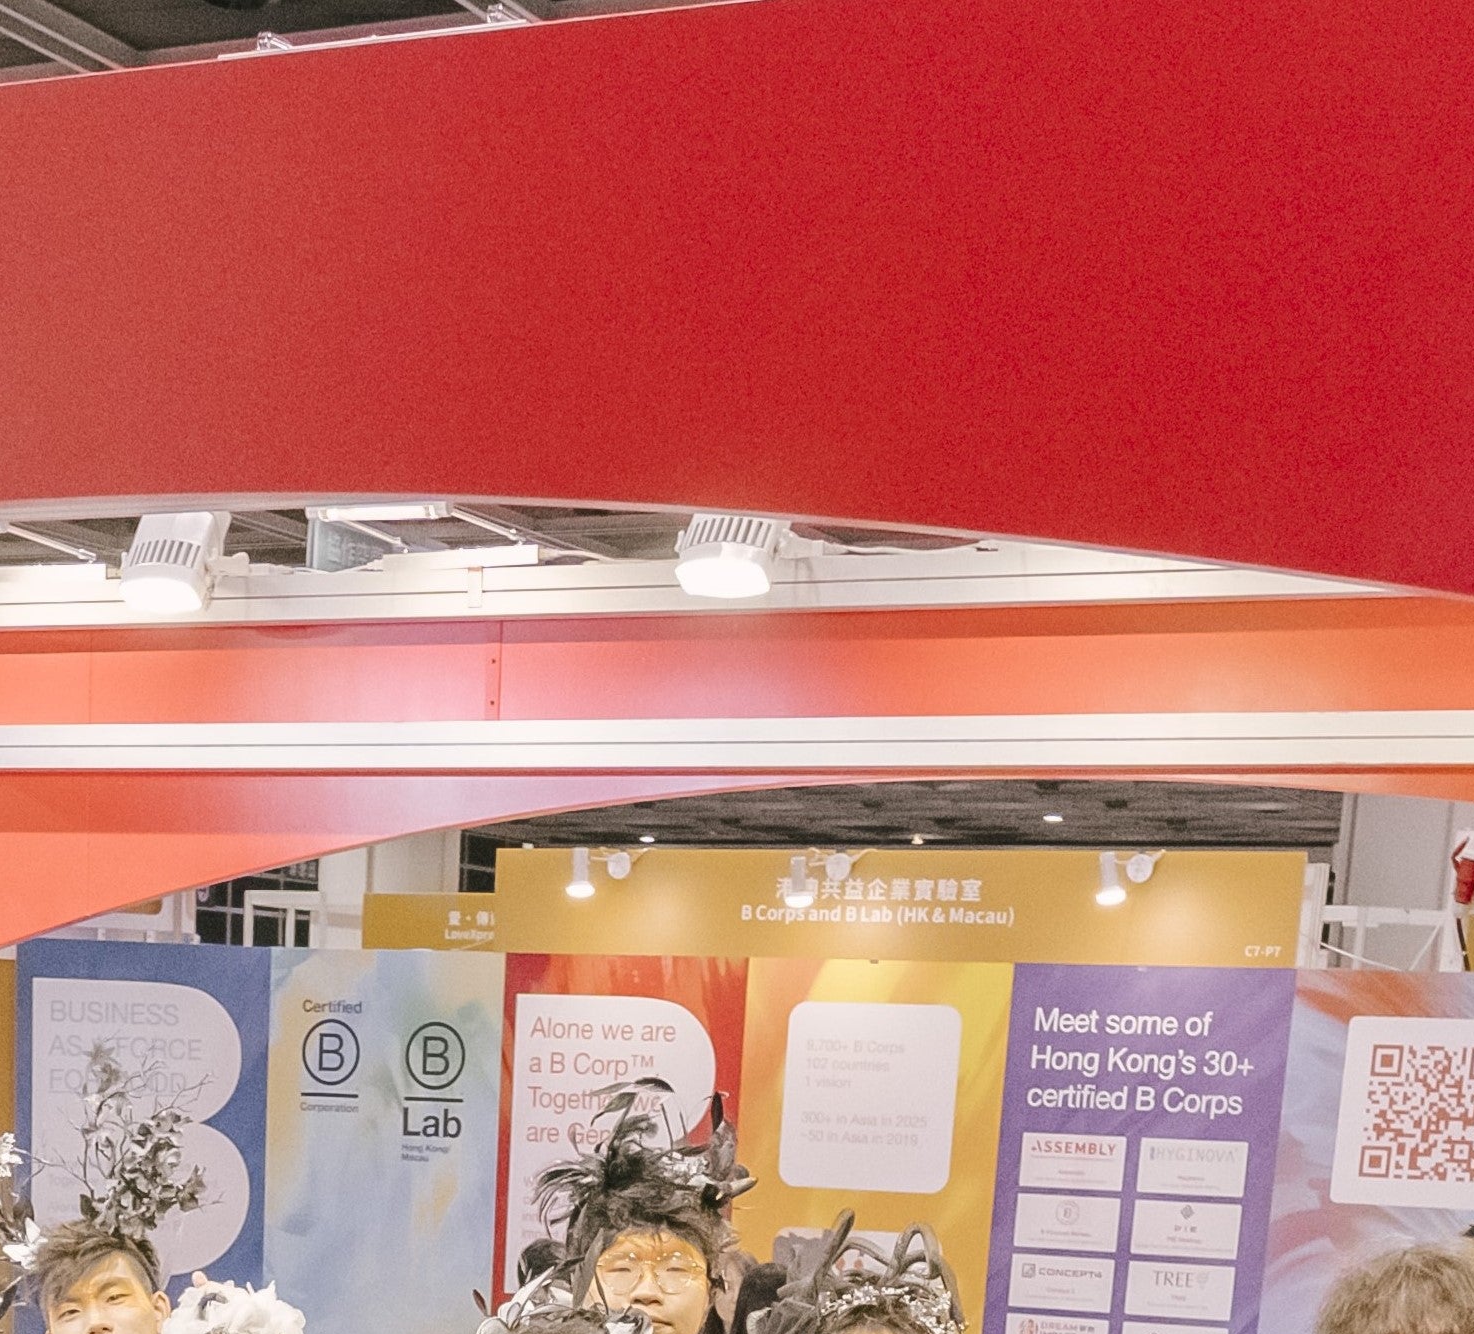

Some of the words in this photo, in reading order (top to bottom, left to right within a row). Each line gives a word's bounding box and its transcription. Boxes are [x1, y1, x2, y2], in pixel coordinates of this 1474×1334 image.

[741, 906, 752, 920] B
[756, 905, 804, 924] Corps
[809, 905, 841, 921] and
[845, 906, 857, 921] B
[860, 906, 893, 922] Lab
[897, 907, 929, 926] (HK
[932, 908, 946, 922] &
[950, 907, 1016, 927] Macau)
[50, 1000, 180, 1027] BUSINESS
[302, 999, 363, 1014] Certified
[530, 1016, 594, 1041] Alone
[602, 1025, 635, 1042] we
[641, 1025, 676, 1042] are
[1034, 1007, 1099, 1034] Meet
[1105, 1015, 1178, 1036] some
[1184, 1011, 1213, 1037] of
[318, 1032, 345, 1072] B
[422, 1036, 450, 1076] B
[528, 1056, 542, 1074] a
[550, 1052, 565, 1074] B
[1030, 1044, 1100, 1078] Hong
[1203, 1050, 1255, 1077] 30+
[1026, 1083, 1128, 1111] certified
[1135, 1086, 1155, 1111] B
[1163, 1086, 1243, 1119] Corps
[403, 1107, 462, 1138] Lab
[526, 1125, 559, 1143] are
[1031, 1139, 1116, 1157] ASSEMBLY
[1154, 1270, 1194, 1288] TREE
